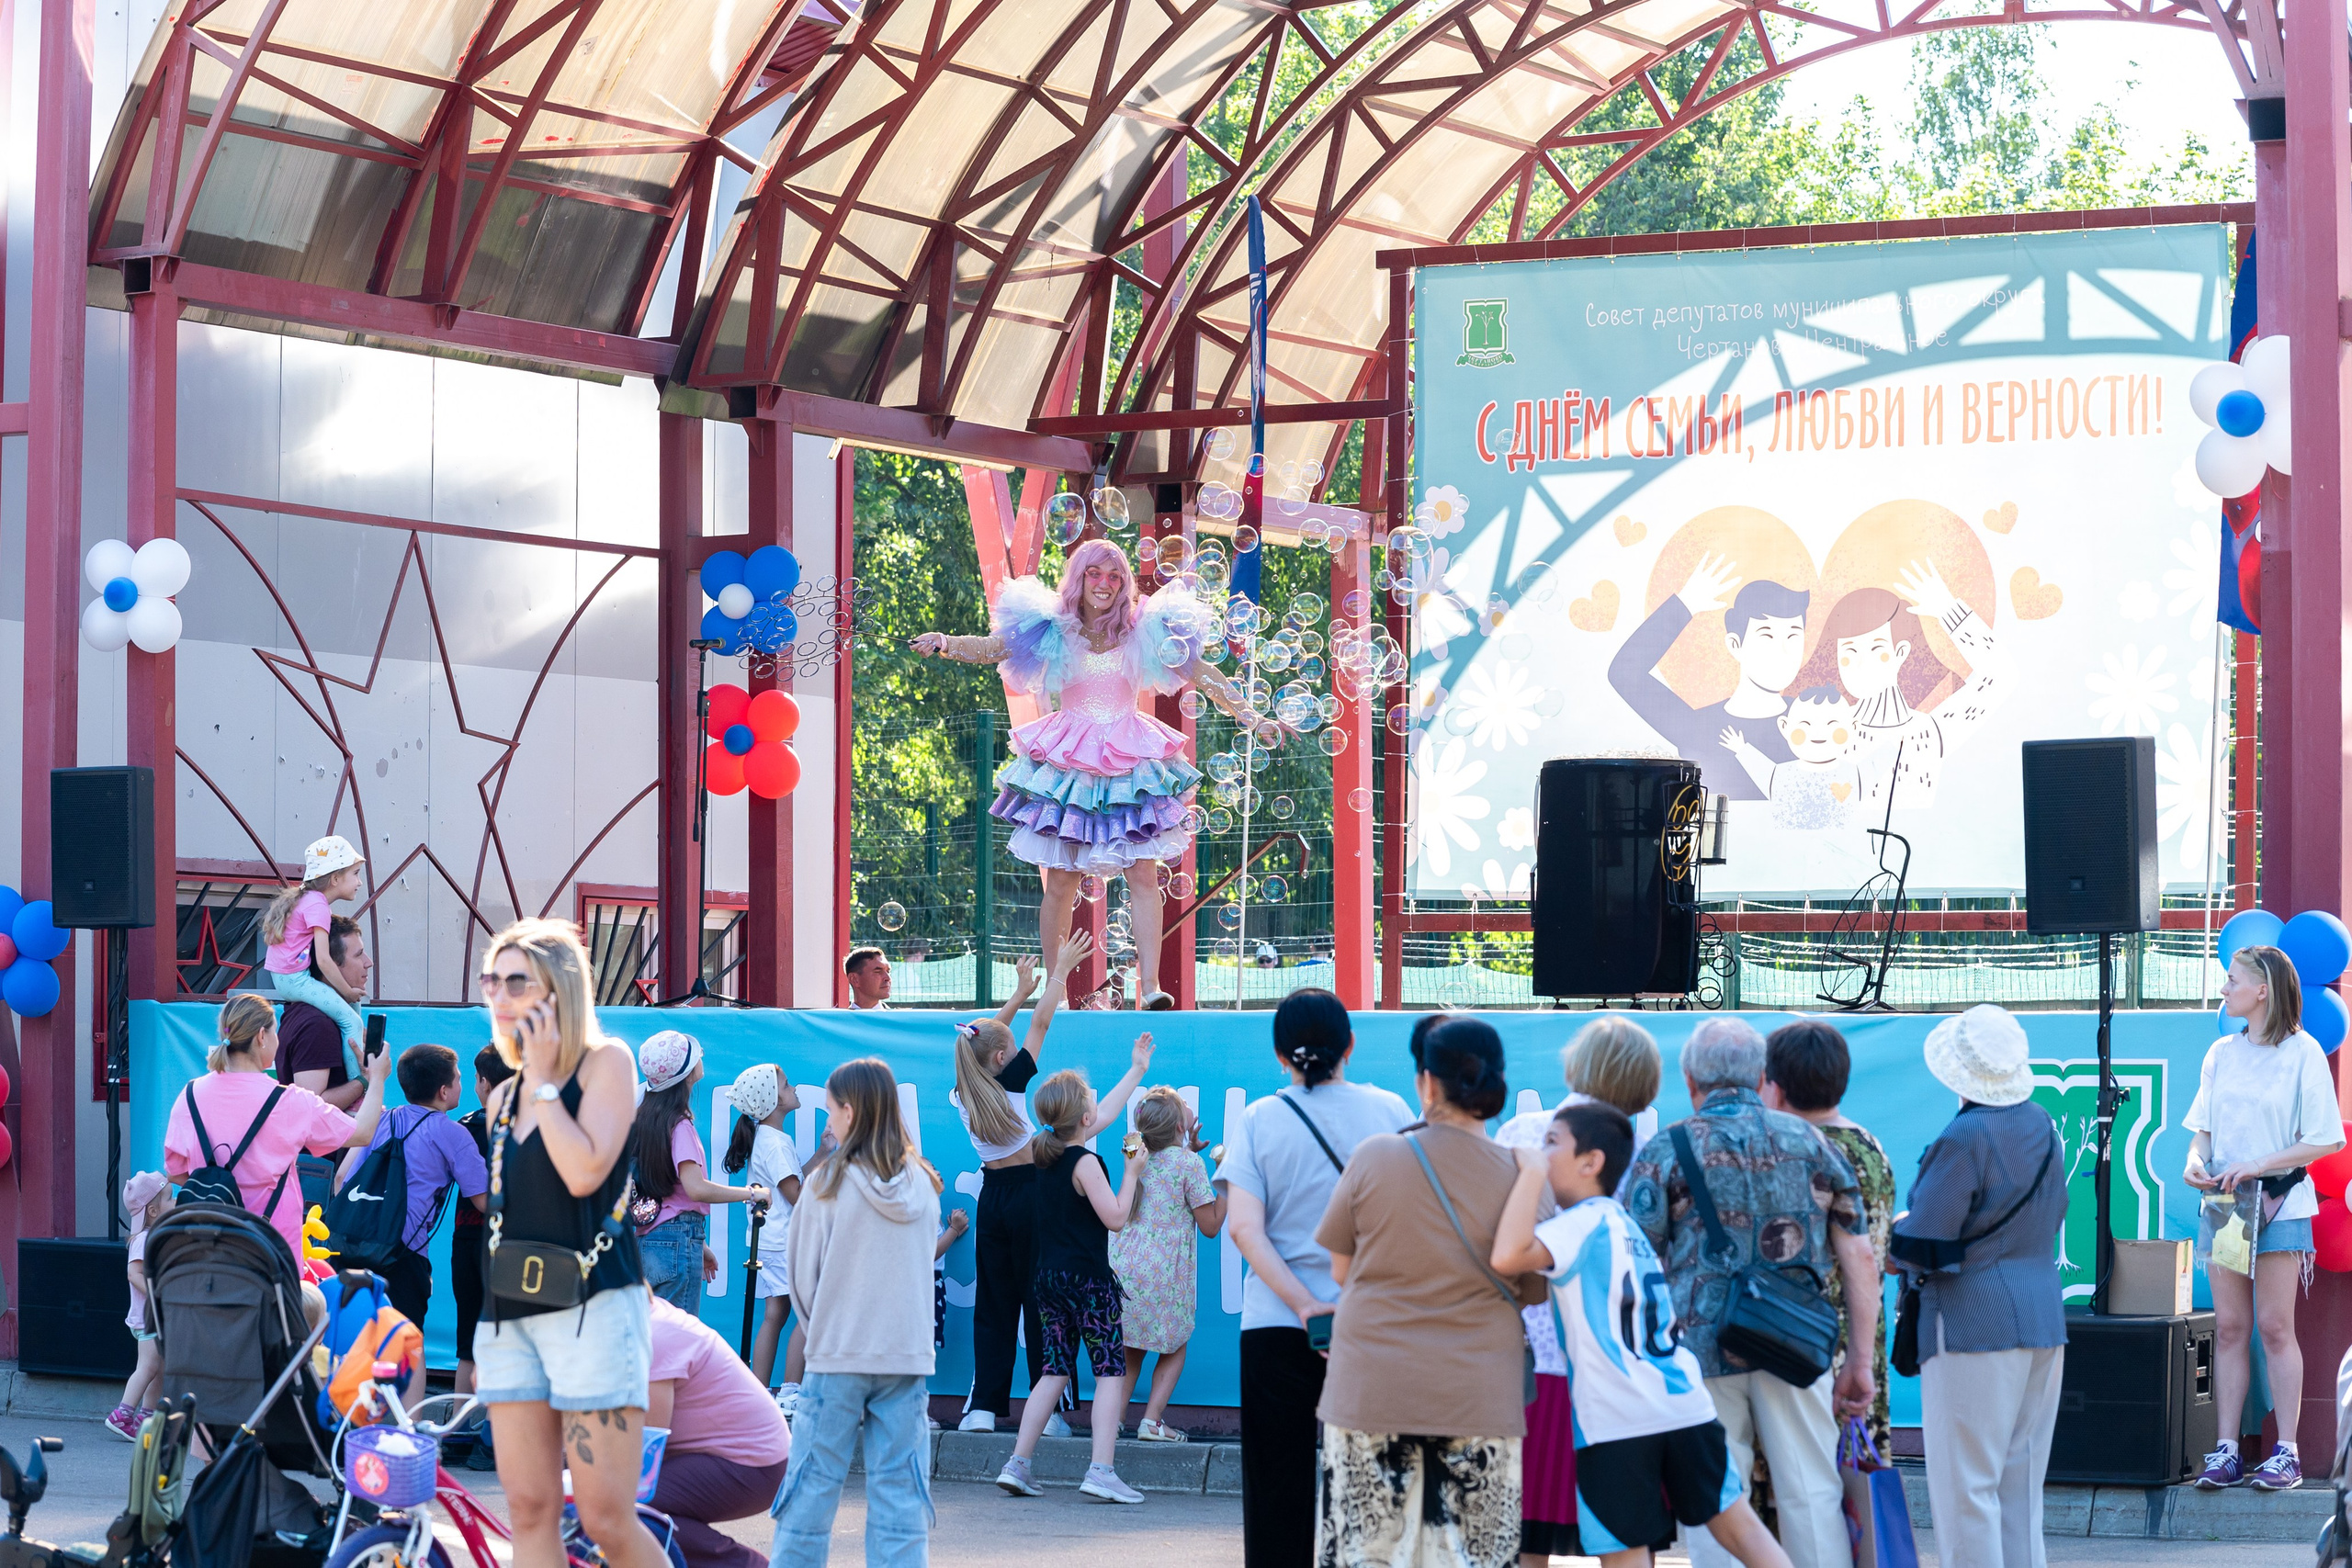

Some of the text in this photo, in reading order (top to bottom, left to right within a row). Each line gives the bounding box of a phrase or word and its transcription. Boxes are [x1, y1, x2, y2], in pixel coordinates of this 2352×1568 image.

[1585, 301, 1645, 328] Совет
[1652, 301, 1764, 333] депутатов
[1967, 288, 2046, 320] округа
[1476, 373, 2163, 473] С ДНЁМ СЕМЬИ, ЛЮБВИ И ВЕРНОСТИ!
[1620, 1269, 1680, 1359] 10
